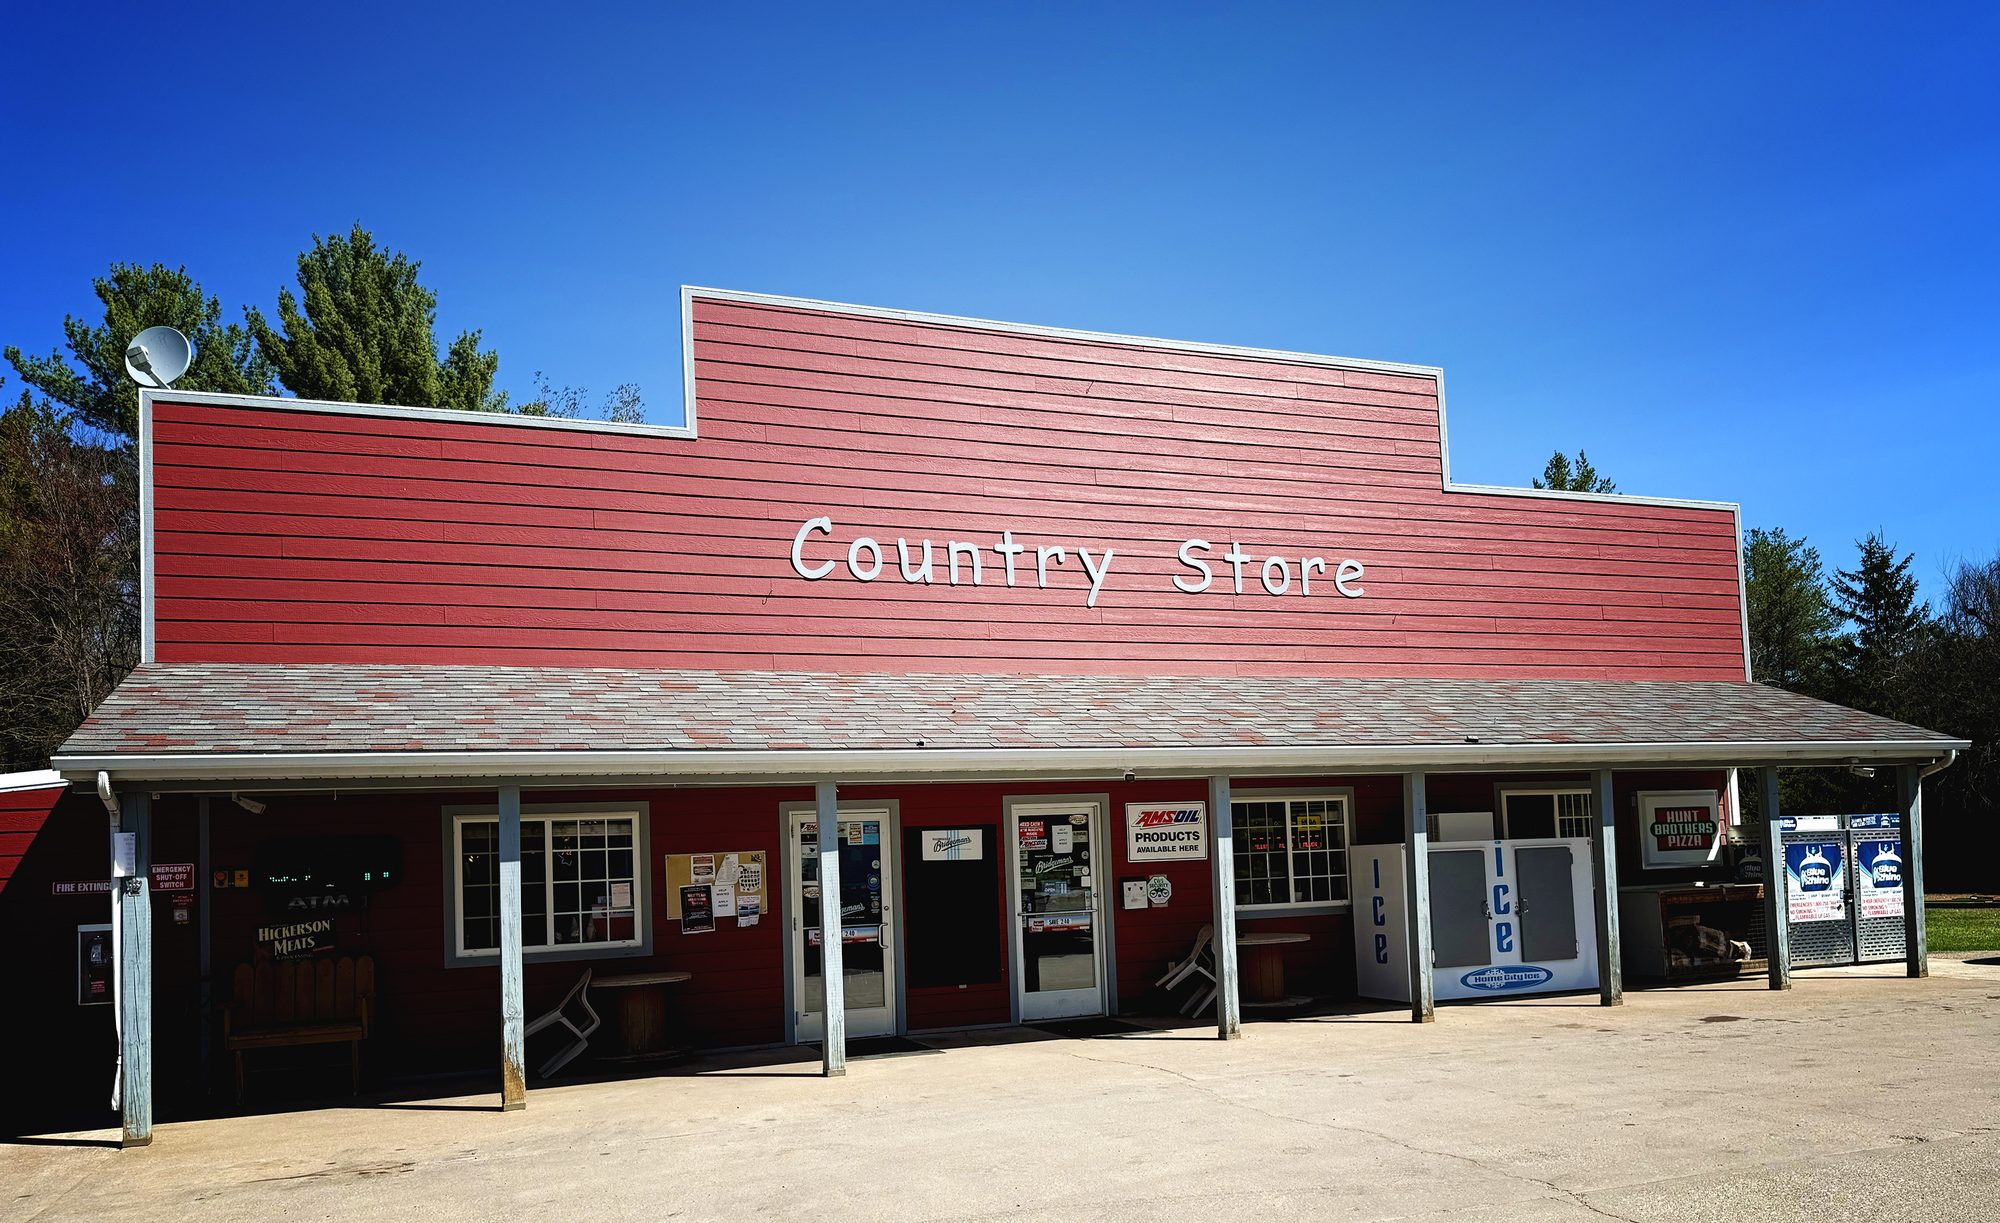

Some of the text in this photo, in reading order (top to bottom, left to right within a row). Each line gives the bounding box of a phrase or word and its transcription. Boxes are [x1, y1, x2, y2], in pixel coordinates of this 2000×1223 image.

[791, 516, 1364, 607] Country Store
[1135, 809, 1200, 828] AMSOIL
[1666, 810, 1699, 823] HUNT
[1654, 823, 1713, 835] BROTHERS
[1135, 831, 1200, 843] PRODUCTS
[1668, 834, 1702, 847] PIZZA
[933, 836, 973, 853] Bridgeman's
[1136, 844, 1199, 854] AVAILABLE HERE
[152, 865, 192, 873] EMERGENCY
[1035, 856, 1074, 875] Bridgeman's
[1877, 864, 1898, 873] Blue
[1806, 868, 1826, 877] Blue
[56, 883, 76, 893] FIRE
[288, 894, 349, 909] ATM
[258, 919, 331, 942] HICKERSON
[274, 936, 316, 957] MEATS
